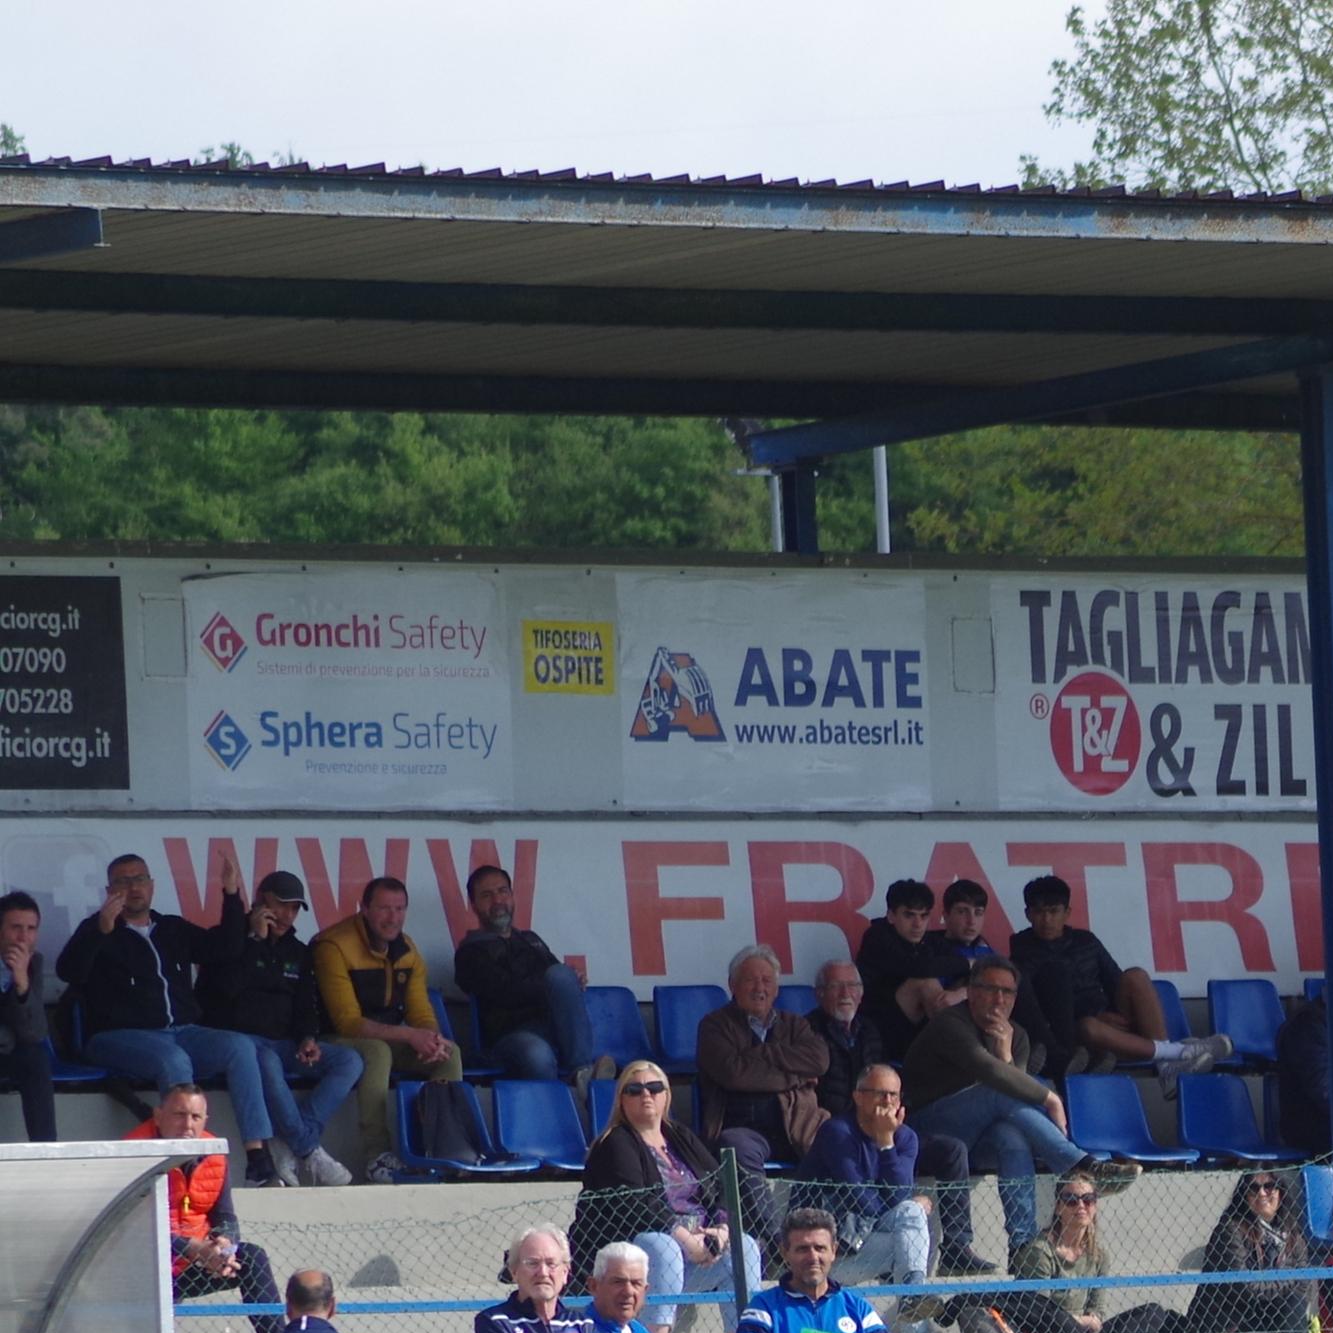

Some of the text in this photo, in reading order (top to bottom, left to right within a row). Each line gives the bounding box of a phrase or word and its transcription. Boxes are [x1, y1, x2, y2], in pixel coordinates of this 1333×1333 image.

[255, 613, 487, 659] Gronchi Safety
[532, 629, 602, 651] TIFOSERIA
[257, 661, 490, 679] Sistemi di prevenzione per la sicurezza
[534, 655, 604, 685] OSPITE
[734, 647, 923, 709] ABATE
[260, 711, 497, 760] Sphera Safety
[735, 718, 923, 745] www.abatesrl.it
[1146, 702, 1197, 797] &
[306, 760, 378, 775] Prevenzione
[391, 761, 447, 775] sicurezza
